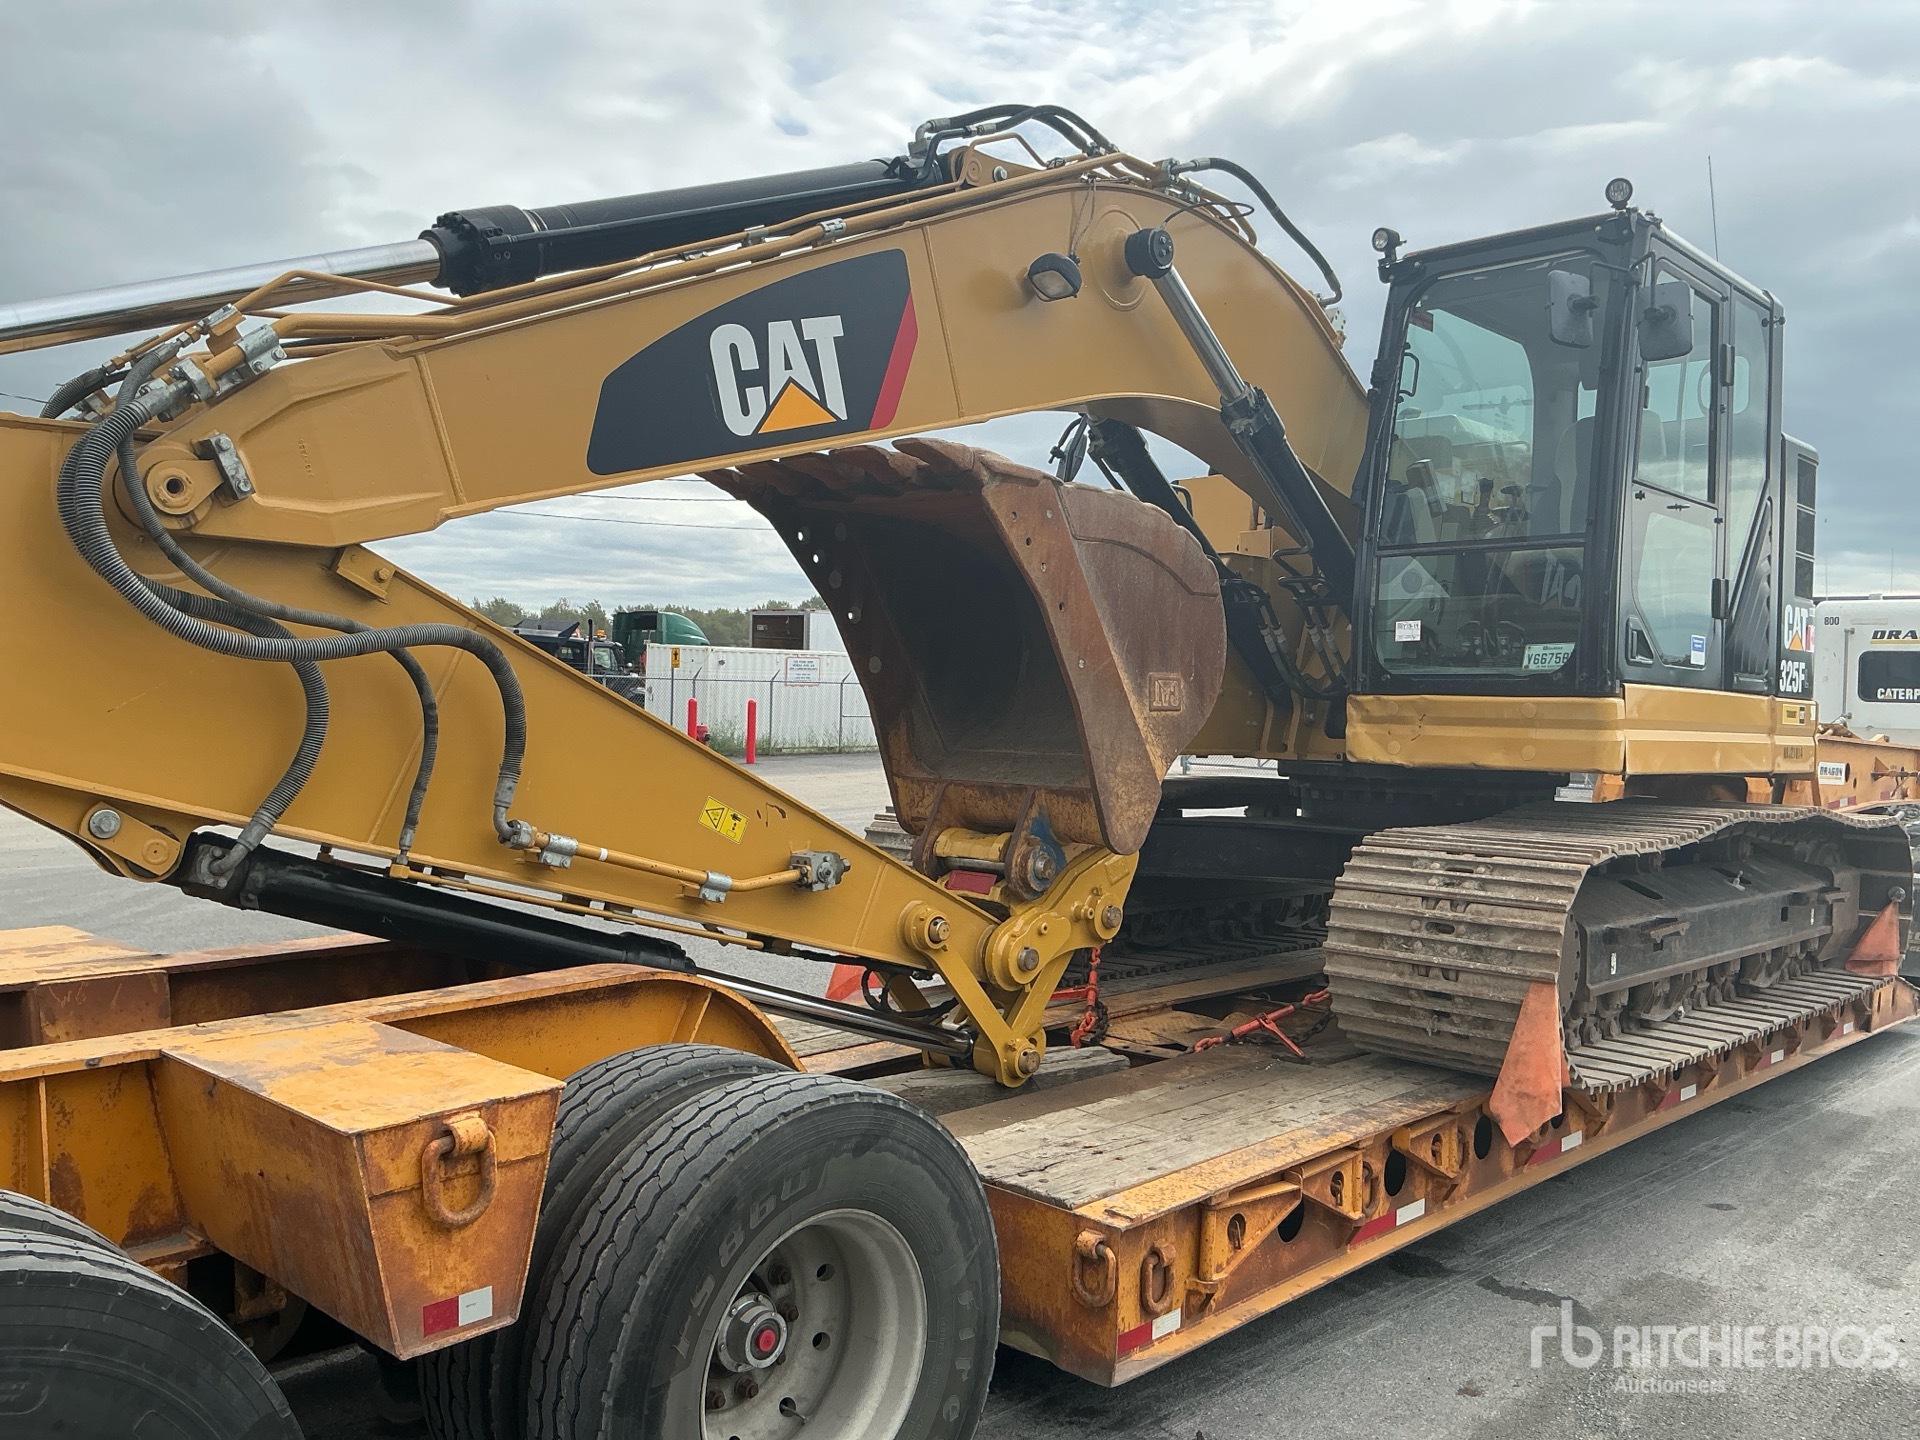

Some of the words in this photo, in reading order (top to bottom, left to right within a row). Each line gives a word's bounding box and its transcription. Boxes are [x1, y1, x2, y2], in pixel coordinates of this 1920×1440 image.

[709, 315, 848, 436] CAT
[1824, 616, 1840, 626] 800
[1784, 604, 1808, 652] CAT
[1871, 629, 1920, 640] DRA
[1779, 659, 1806, 693] 325F
[1877, 687, 1920, 700] CATERP
[1820, 766, 1844, 777] DRAGON
